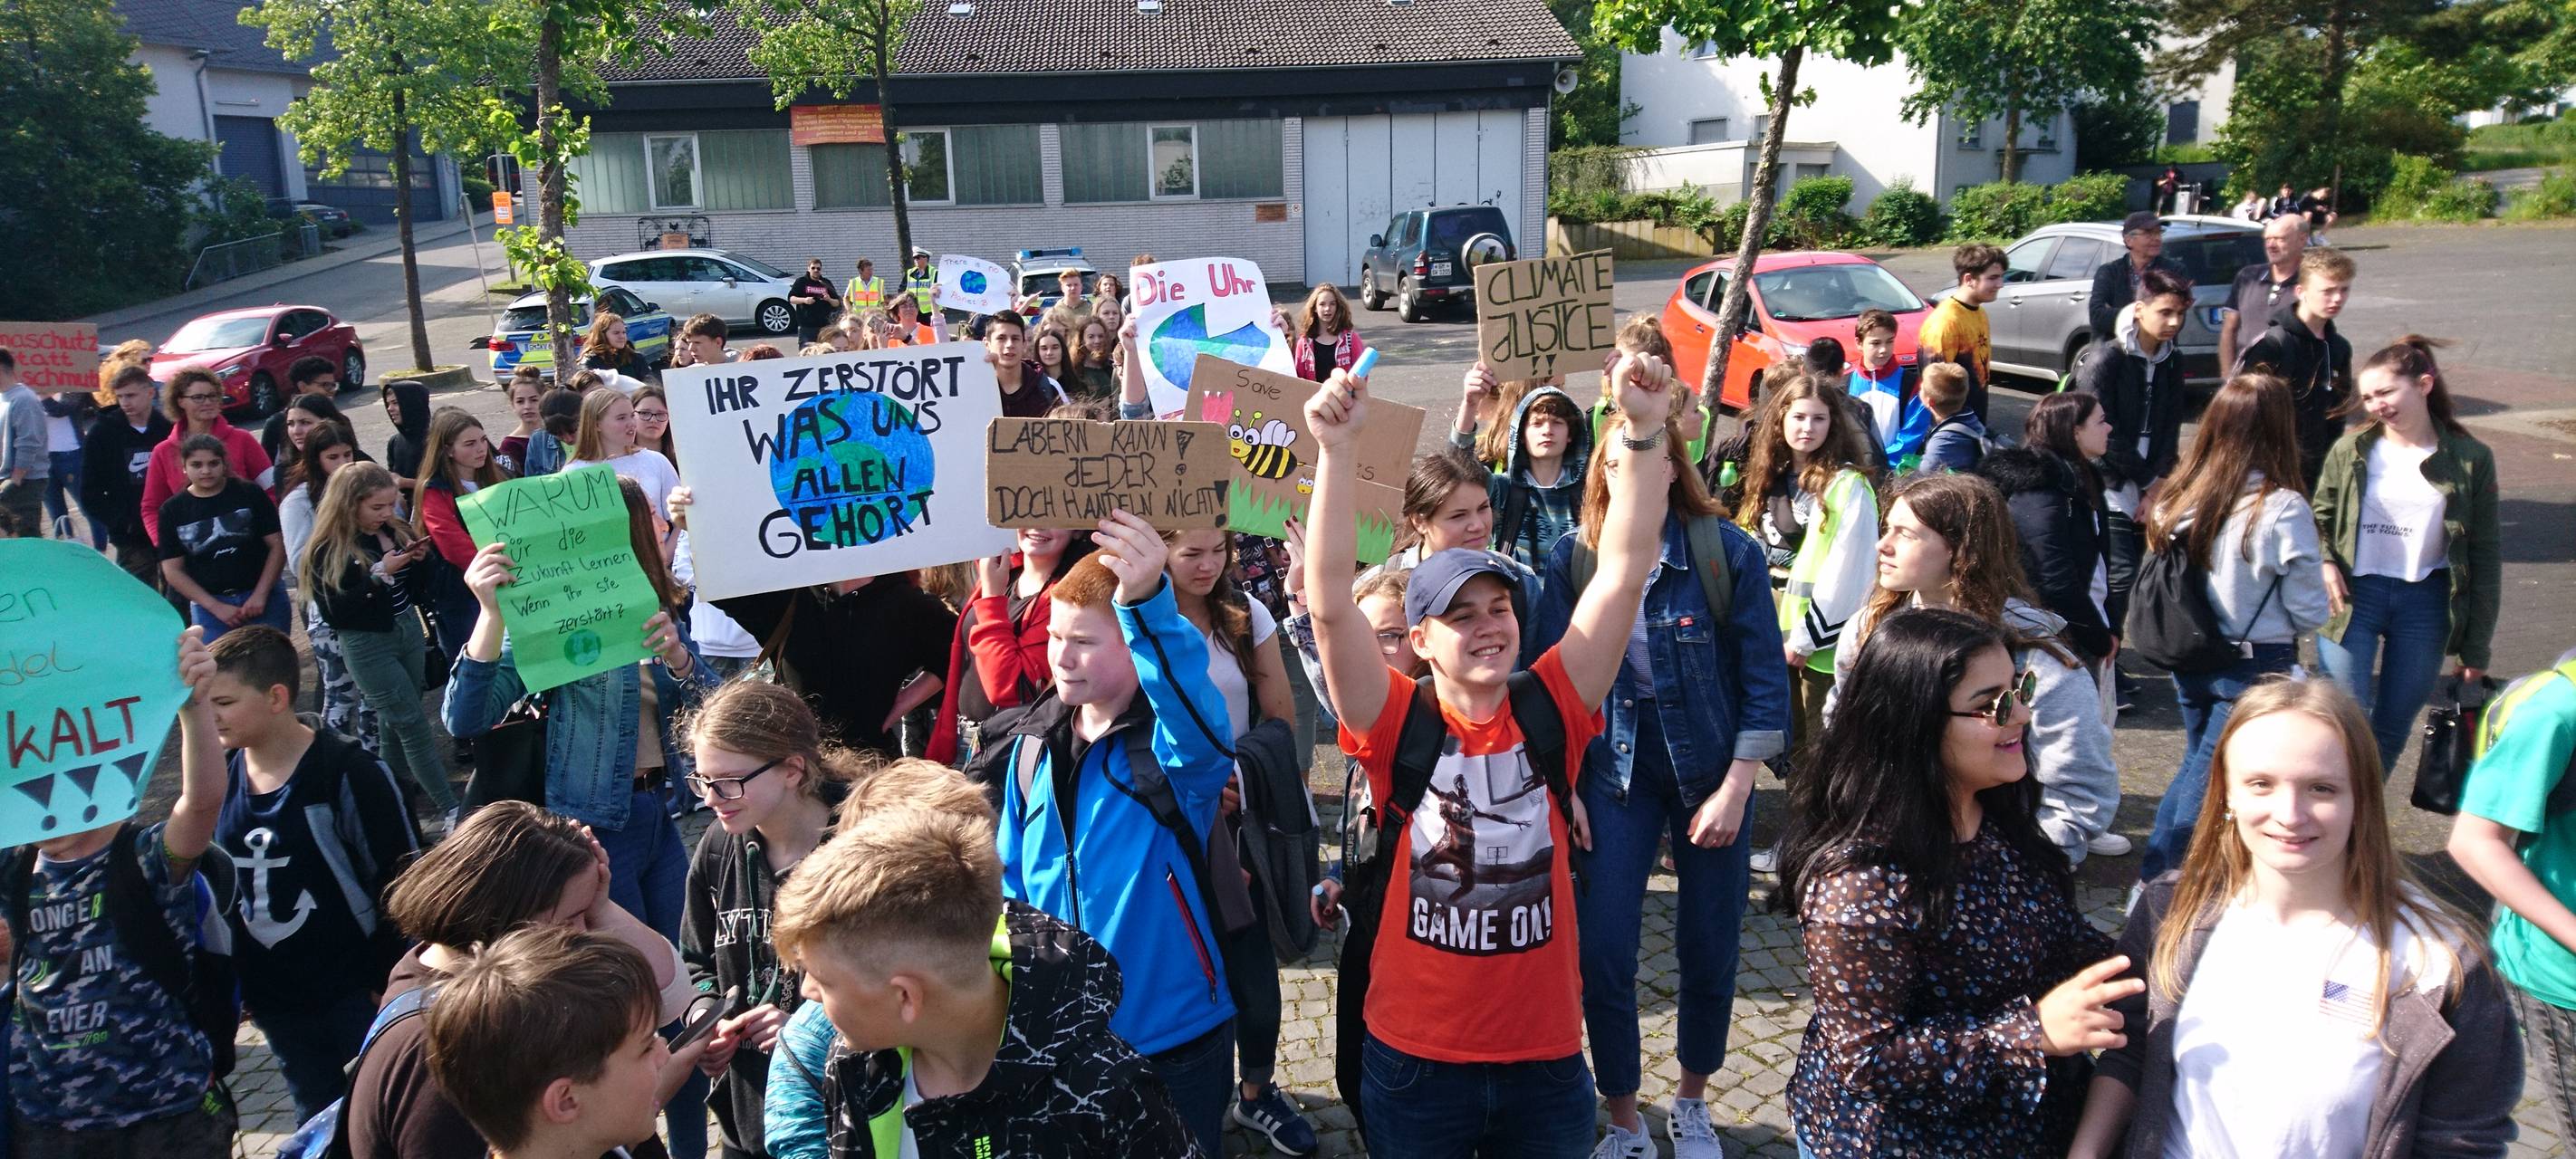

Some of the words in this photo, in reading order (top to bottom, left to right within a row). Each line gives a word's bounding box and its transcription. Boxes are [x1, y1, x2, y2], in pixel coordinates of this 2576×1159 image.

[1136, 270, 1185, 307] Die
[1208, 263, 1255, 297] Uhr
[1488, 252, 1613, 306] CLIMATE
[1487, 299, 1615, 362] JUSTICE
[706, 375, 760, 415] IHR
[783, 357, 966, 401] ZERSTÖRT
[1235, 369, 1283, 400] Save
[743, 398, 851, 465] WAS
[871, 400, 941, 436] UNS
[992, 420, 1089, 455] LABERN
[1110, 422, 1167, 454] KANN
[792, 456, 906, 499] ALLEN
[1064, 453, 1158, 492] JEDER
[473, 470, 614, 529] WARUM
[995, 485, 1056, 523] DOCH
[1062, 487, 1152, 520] HANDELN
[558, 522, 586, 551] die
[758, 490, 934, 559] GEHÖRT
[507, 561, 574, 589] Zukunft
[511, 596, 551, 617] Wenn
[1413, 897, 1500, 951] GAME
[1511, 896, 1552, 947] ON!
[46, 1000, 109, 1034] EVER
